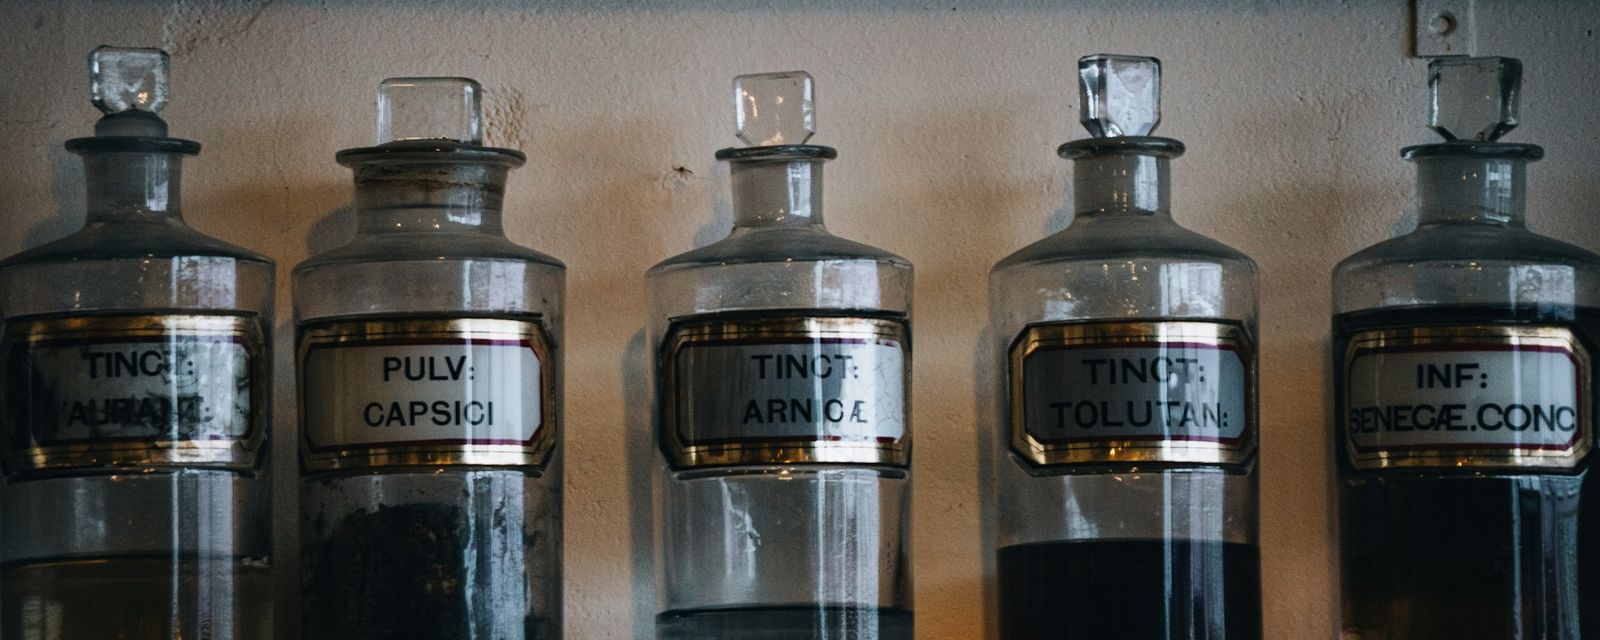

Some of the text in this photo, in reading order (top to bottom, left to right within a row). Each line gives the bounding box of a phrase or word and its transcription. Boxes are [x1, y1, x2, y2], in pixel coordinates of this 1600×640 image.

[382, 355, 475, 382] PULV:
[751, 353, 859, 380] TINCT:
[1081, 356, 1205, 385] TINCT:
[1416, 362, 1488, 389] INF:
[363, 400, 494, 427] CAPSICI
[1051, 401, 1228, 429] TOLUTAN:
